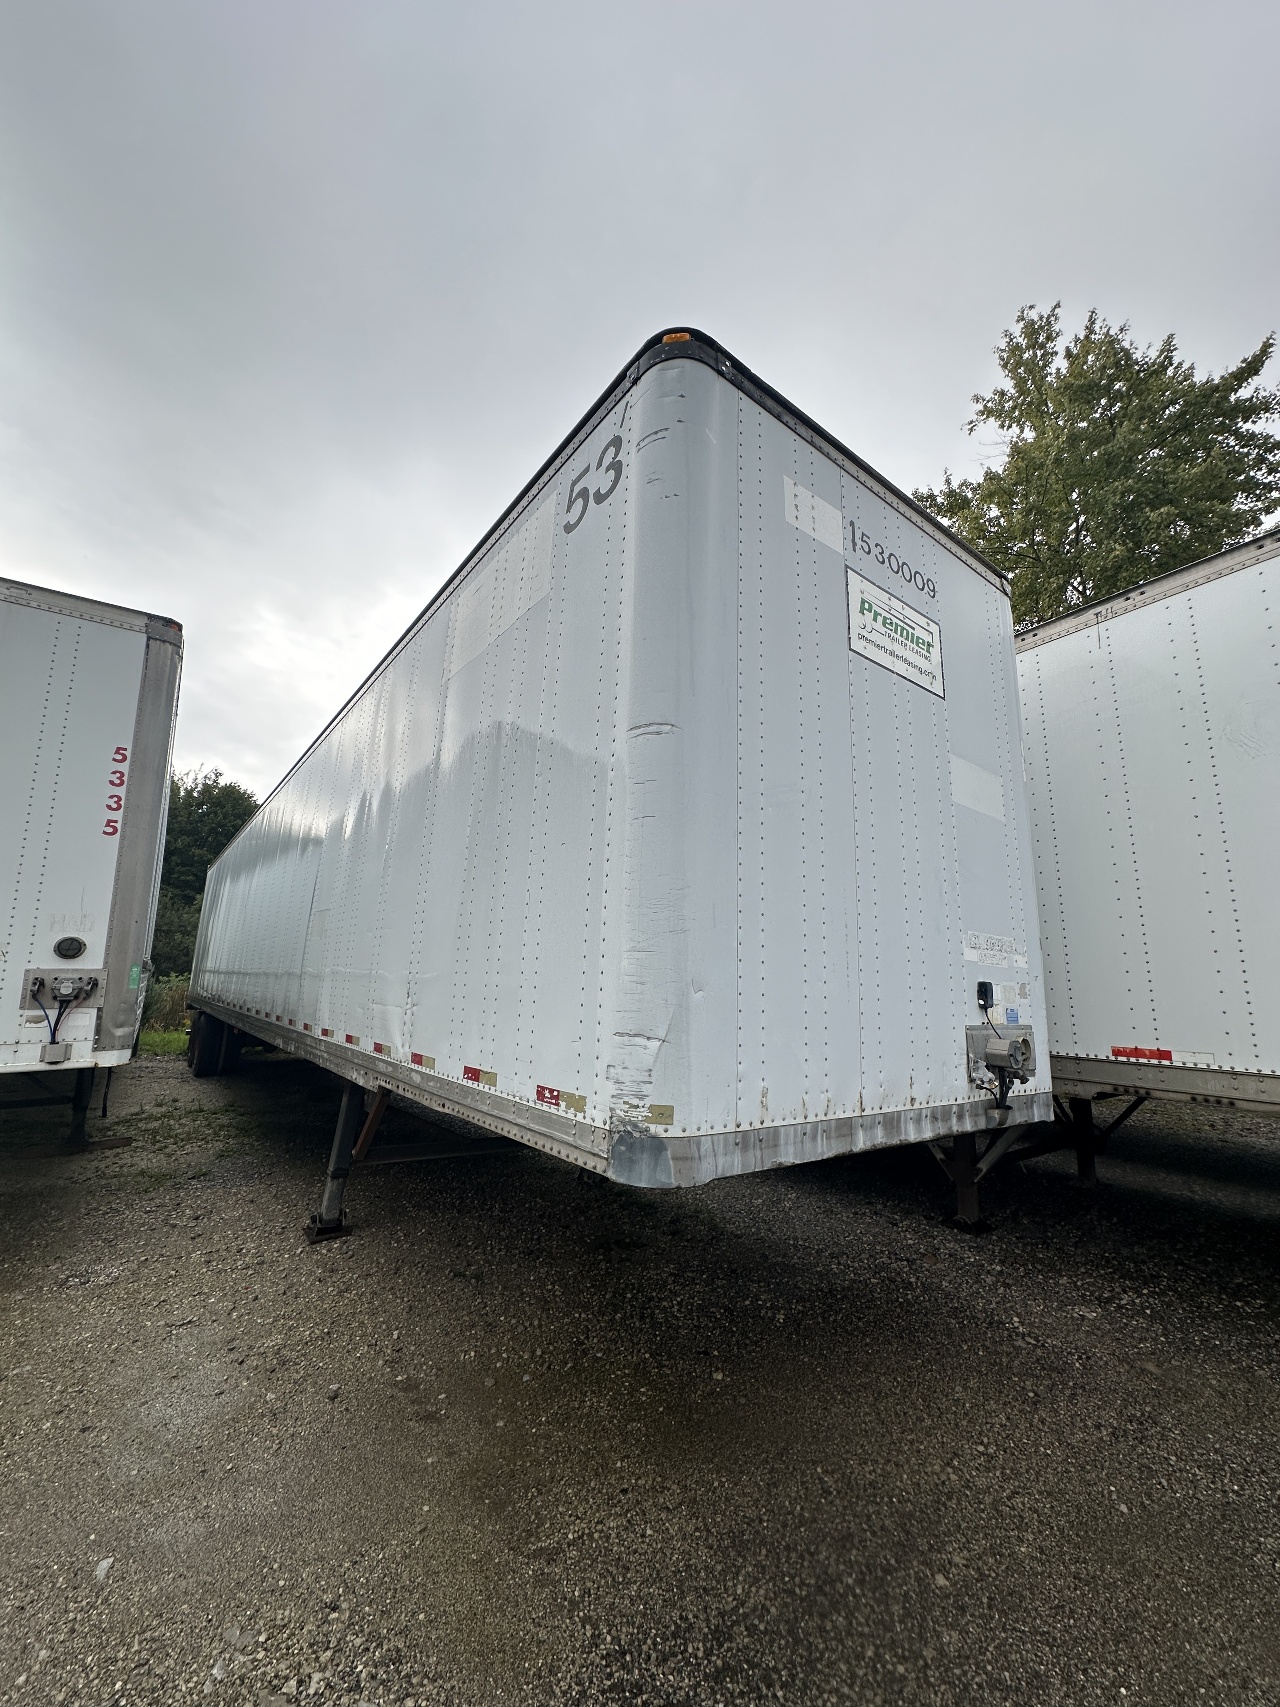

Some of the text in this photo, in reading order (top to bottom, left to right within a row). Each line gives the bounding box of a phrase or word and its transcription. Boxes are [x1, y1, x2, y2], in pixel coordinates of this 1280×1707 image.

[849, 519, 936, 599] 1530009
[859, 598, 934, 654] Premier
[884, 631, 931, 662] TRAILER LEASING
